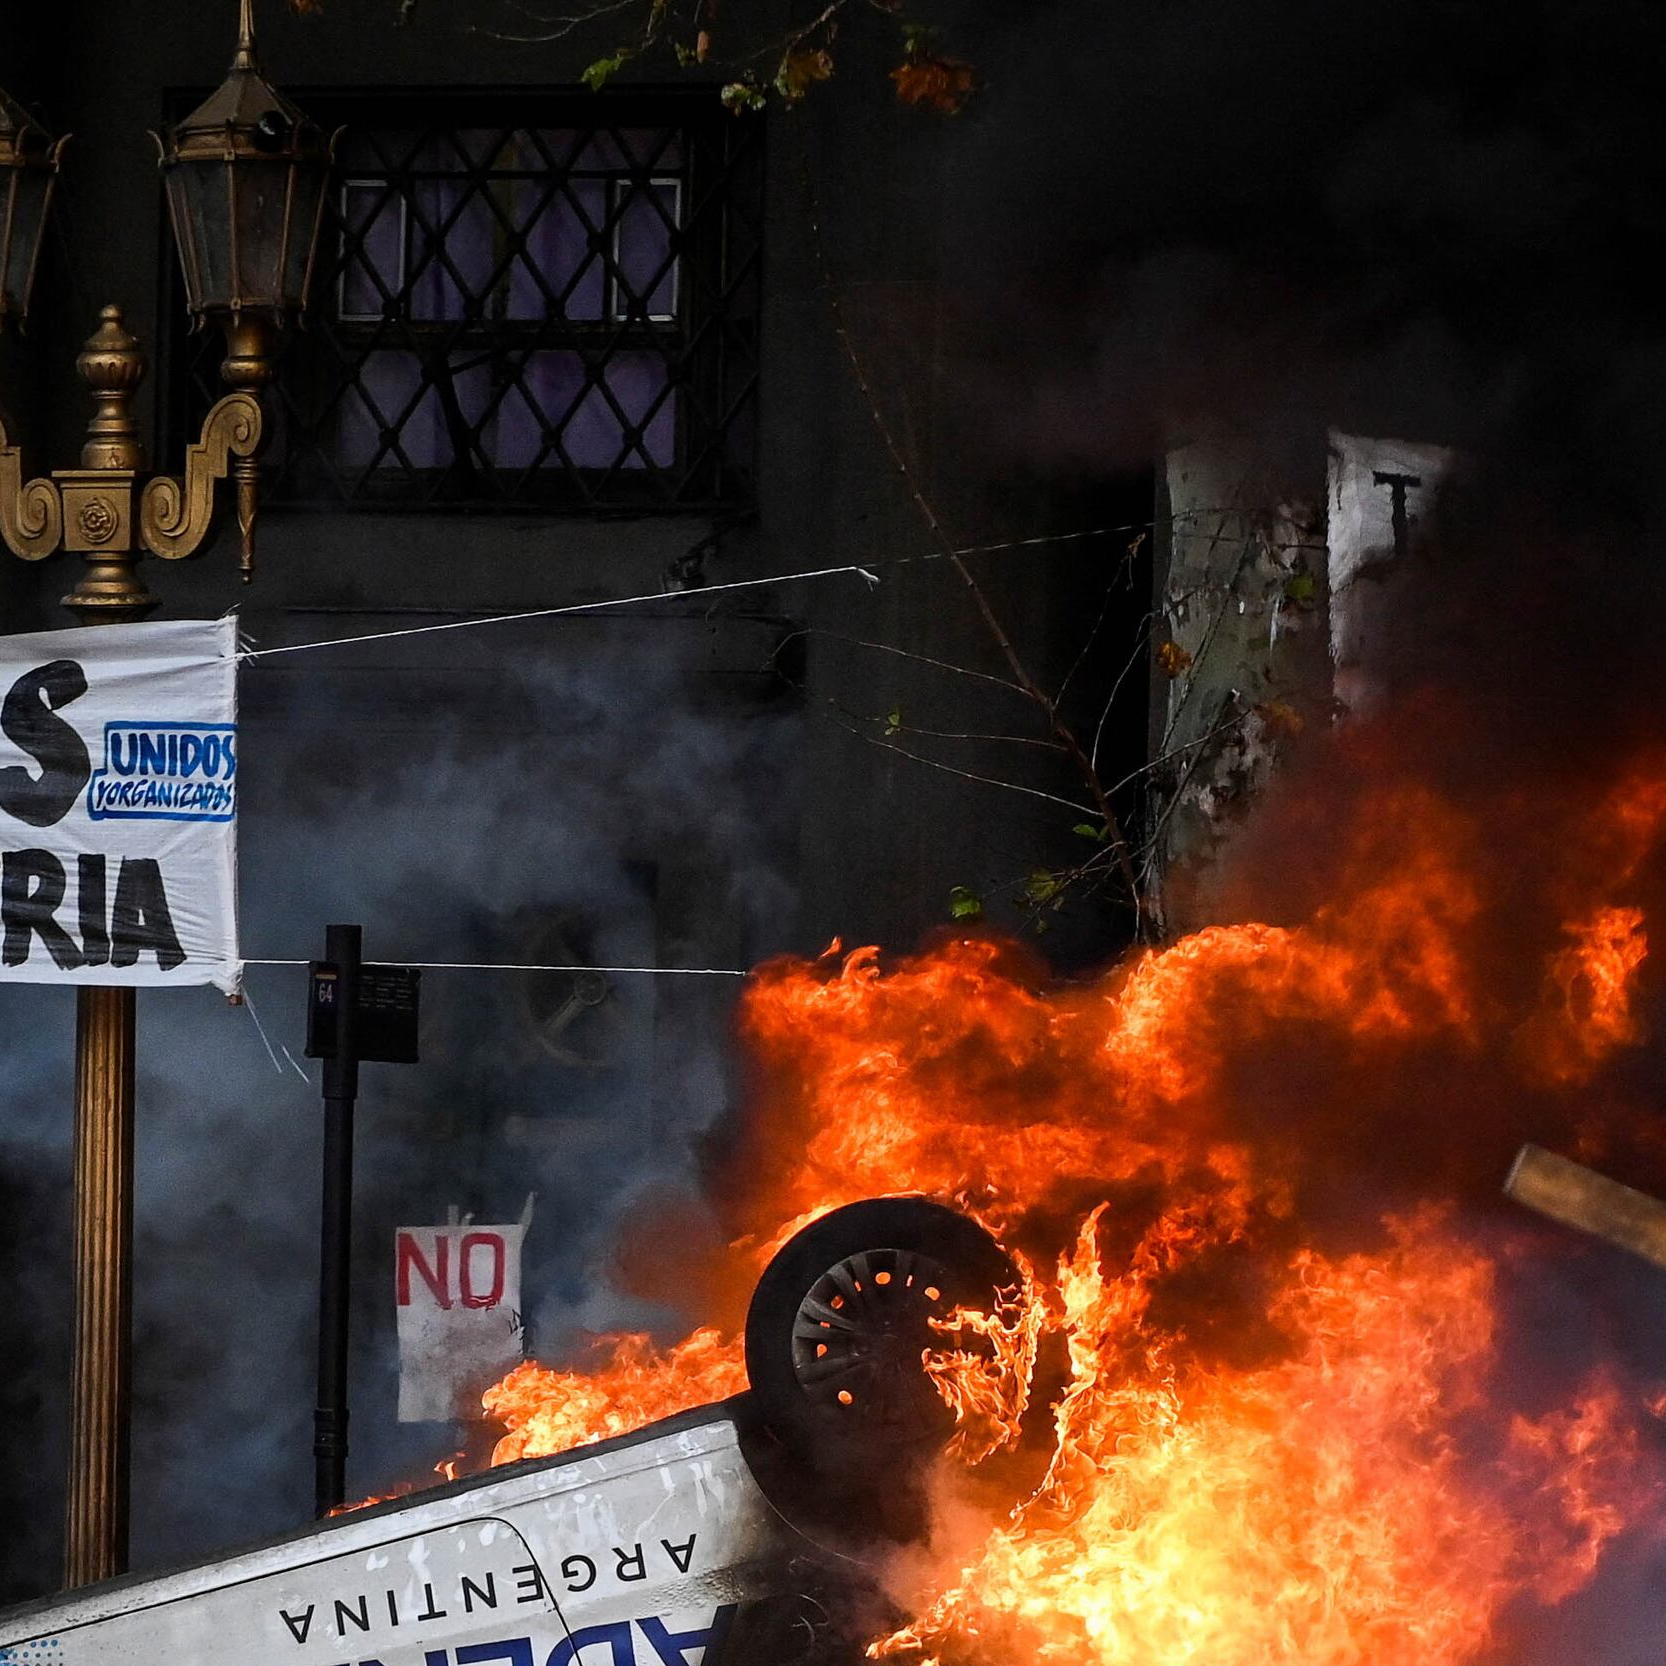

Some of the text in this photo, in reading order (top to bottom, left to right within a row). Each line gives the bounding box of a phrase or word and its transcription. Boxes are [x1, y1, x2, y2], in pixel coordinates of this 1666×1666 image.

[111, 732, 235, 780] UNIDOS
[398, 1232, 505, 1310] NO
[279, 1533, 697, 1644] ARGENTINA
